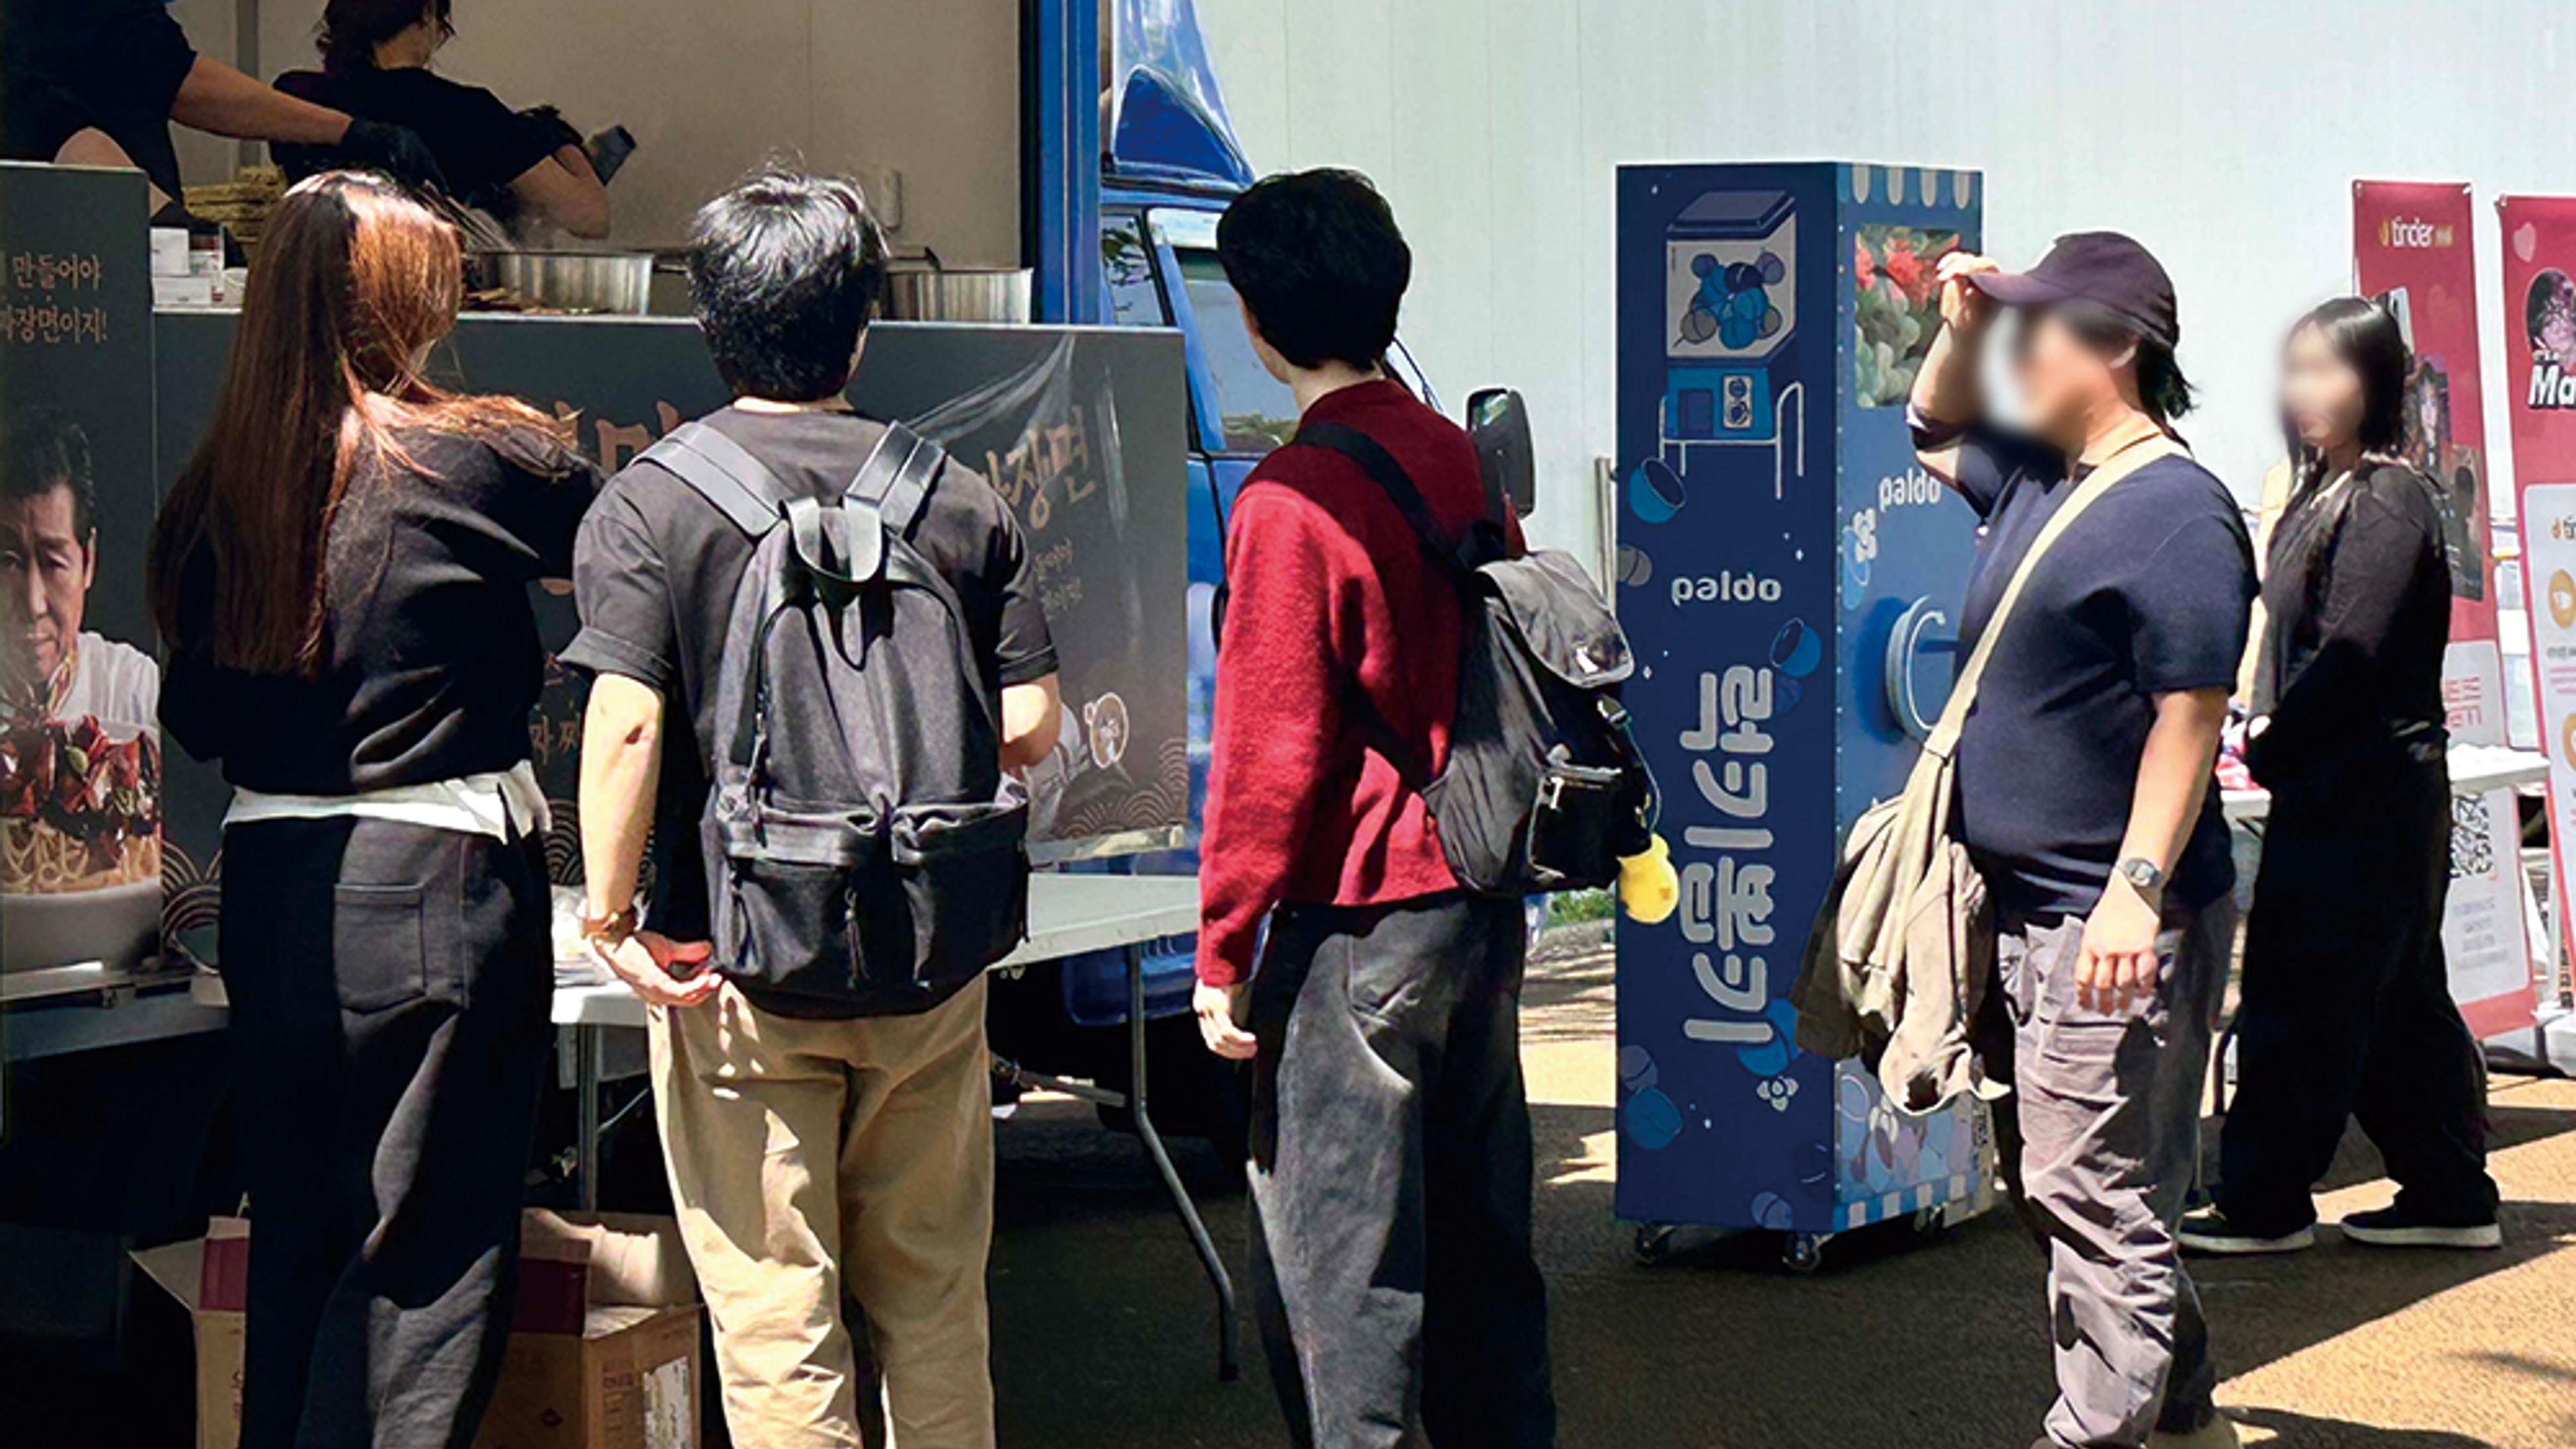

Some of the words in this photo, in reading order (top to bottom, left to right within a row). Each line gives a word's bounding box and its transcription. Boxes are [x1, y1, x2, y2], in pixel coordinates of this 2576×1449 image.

[1880, 468, 1941, 513] paldo
[1671, 570, 1782, 606] paldo
[1678, 664, 1776, 1044] 럭키뽑키
